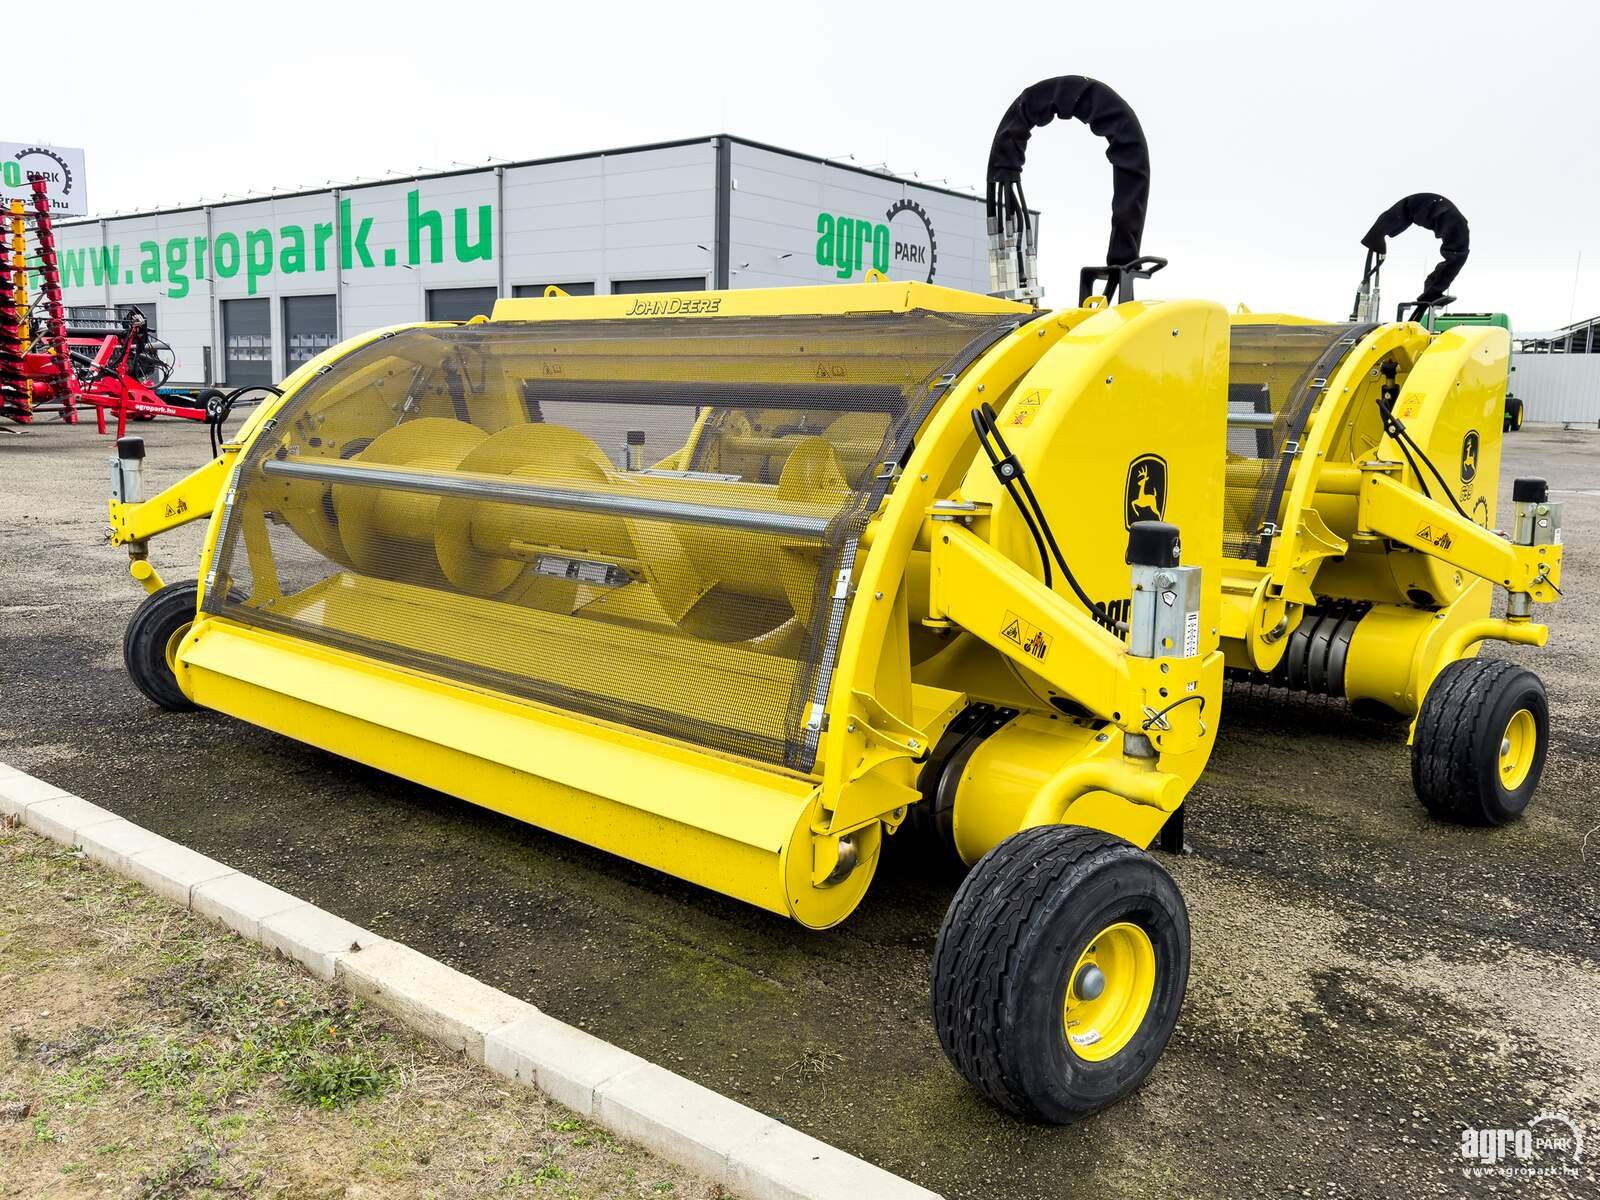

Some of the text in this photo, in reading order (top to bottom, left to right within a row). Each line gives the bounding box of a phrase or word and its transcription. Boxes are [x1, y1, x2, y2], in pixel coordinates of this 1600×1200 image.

[816, 212, 926, 279] agro PARK
[626, 298, 721, 315] JOHN DEERE
[135, 404, 176, 414] agropark.hu
